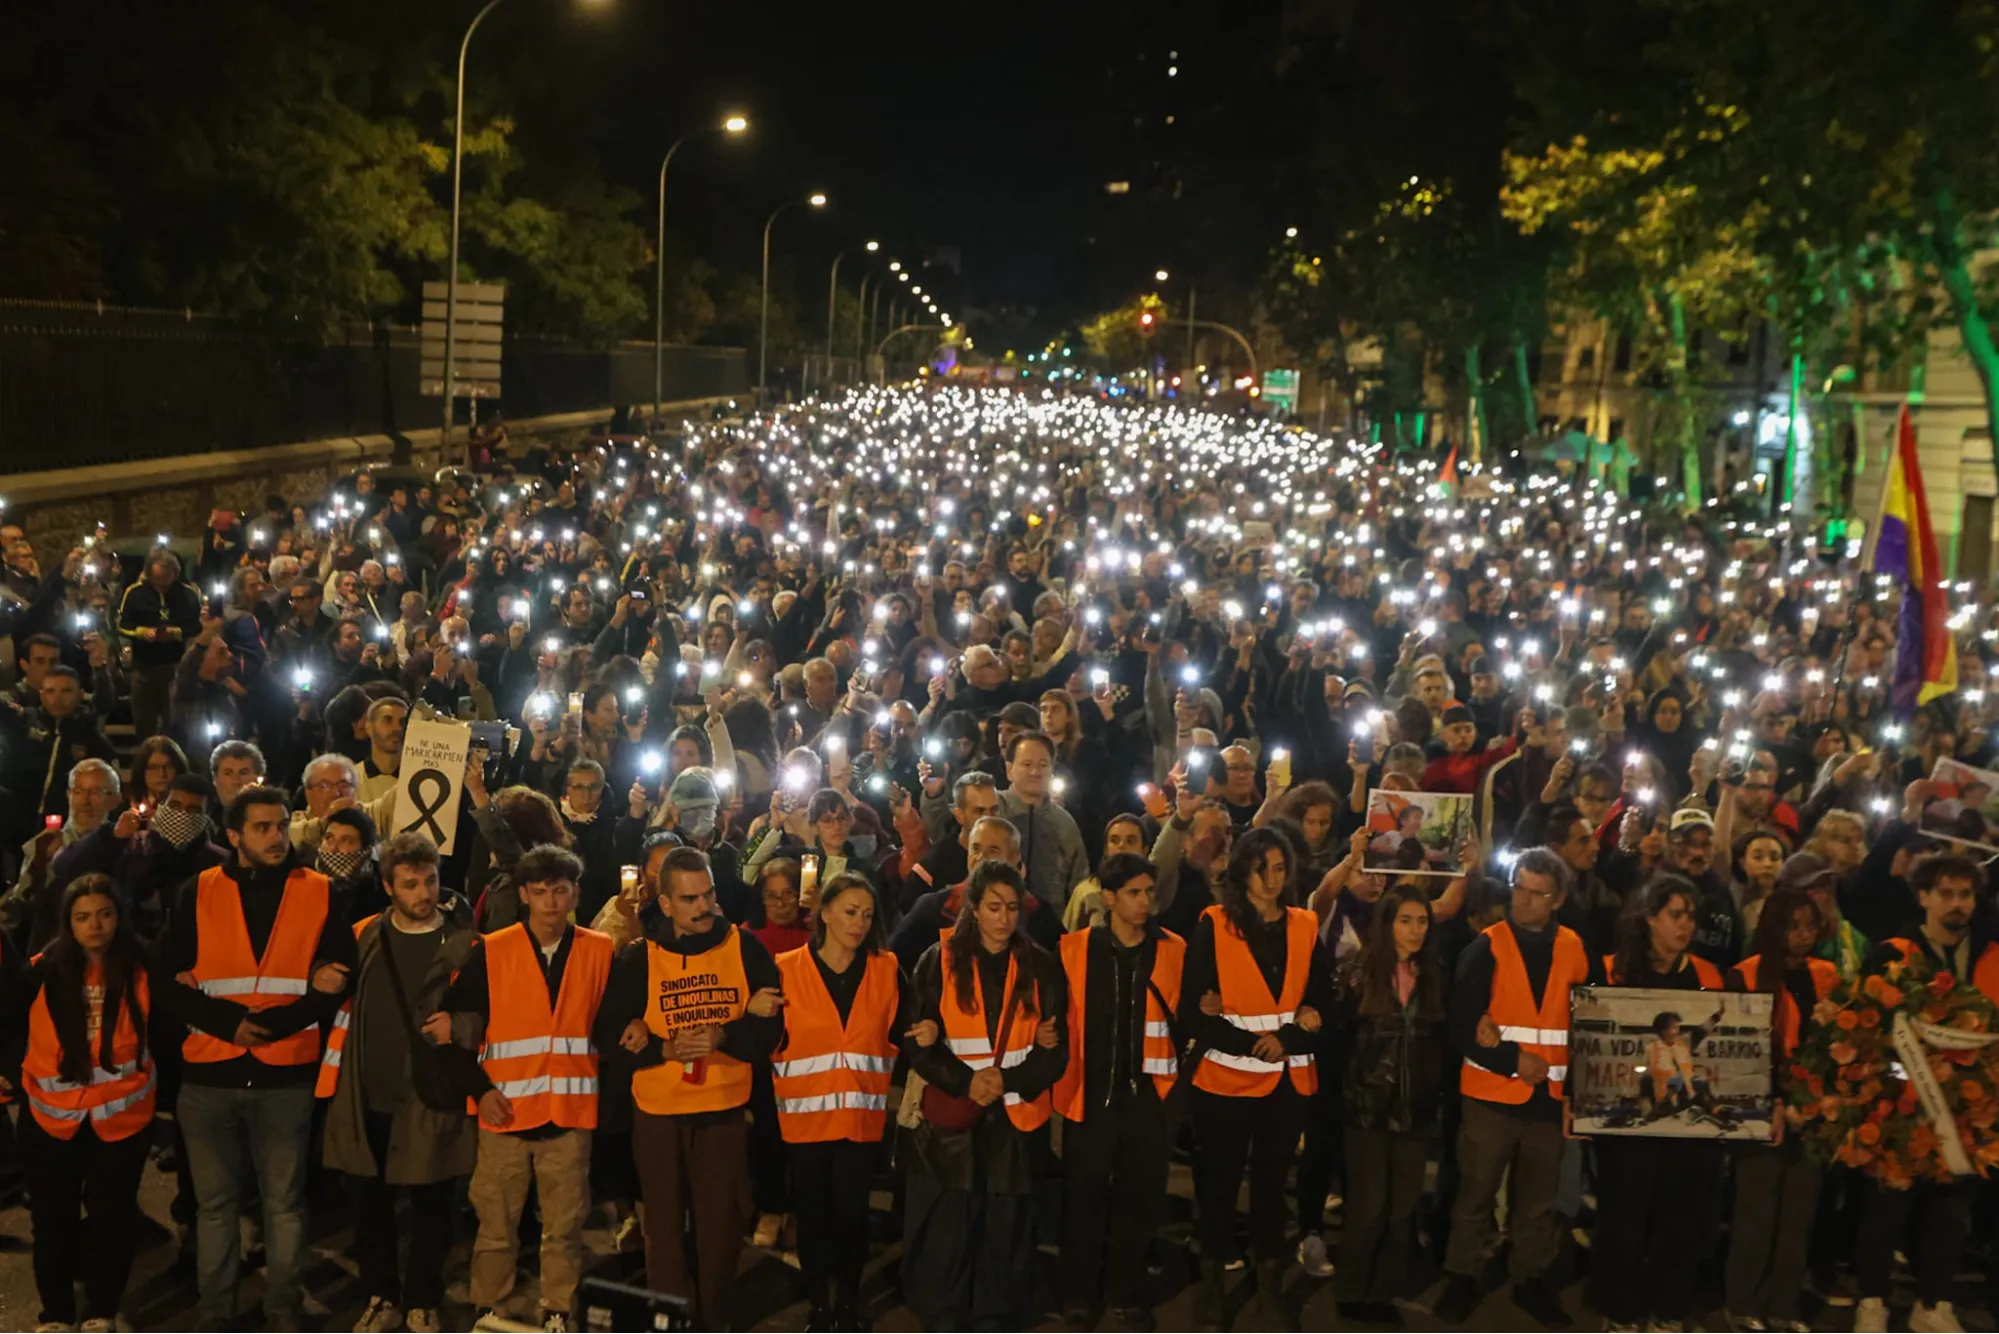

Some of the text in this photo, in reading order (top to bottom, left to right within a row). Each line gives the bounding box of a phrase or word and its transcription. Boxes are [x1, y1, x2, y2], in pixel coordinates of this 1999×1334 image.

[405, 745, 463, 763] MARICARMEN
[432, 741, 450, 751] UNA
[661, 974, 718, 992] SINDICATO
[662, 989, 736, 1010] DE INQUILINAS
[665, 1013, 673, 1026] E
[673, 1006, 730, 1024] INQUILINOS
[1610, 1039, 1645, 1057] VIDA
[1707, 1040, 1763, 1058] BARRIO
